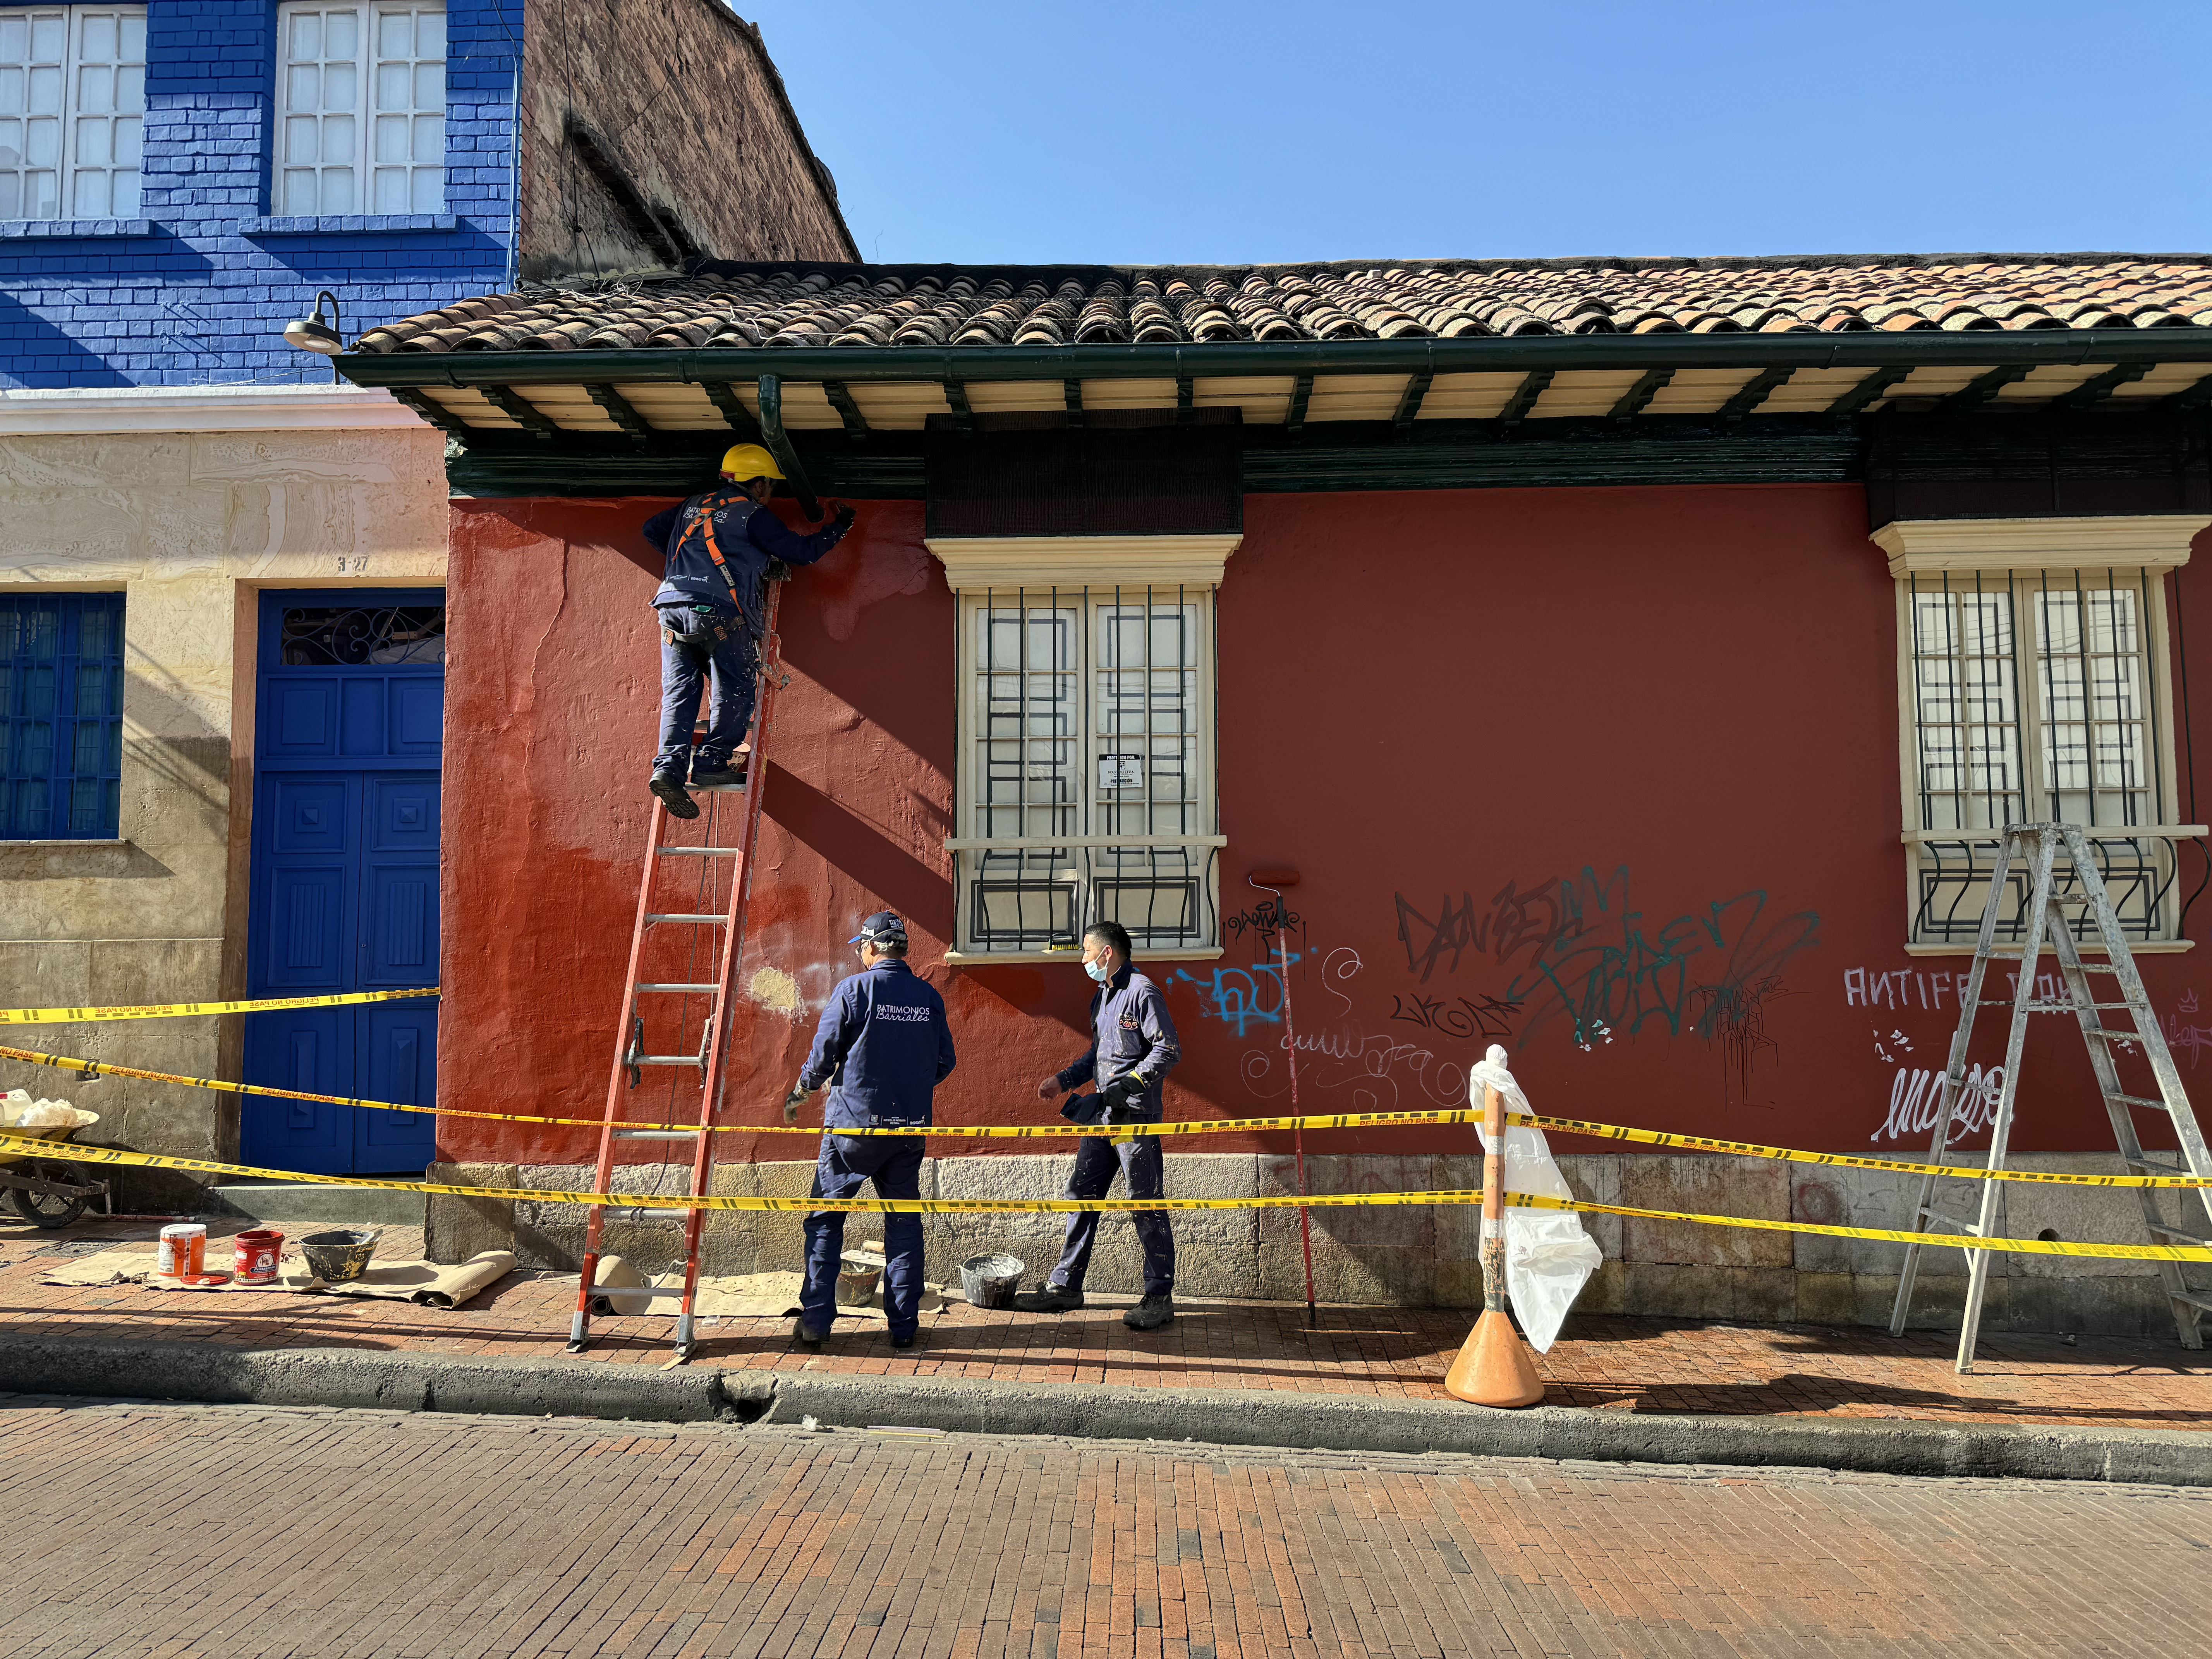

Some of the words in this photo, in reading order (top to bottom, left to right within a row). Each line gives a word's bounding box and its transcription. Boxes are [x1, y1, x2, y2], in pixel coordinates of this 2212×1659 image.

[876, 1008, 929, 1021] Barriales
[877, 1004, 929, 1015] PATRIMONIOS
[13, 1049, 35, 1058] PASE
[110, 1066, 147, 1076] PELIGRO
[1520, 1120, 1559, 1130] PELIGRO
[18, 1145, 55, 1153] PELIGRO
